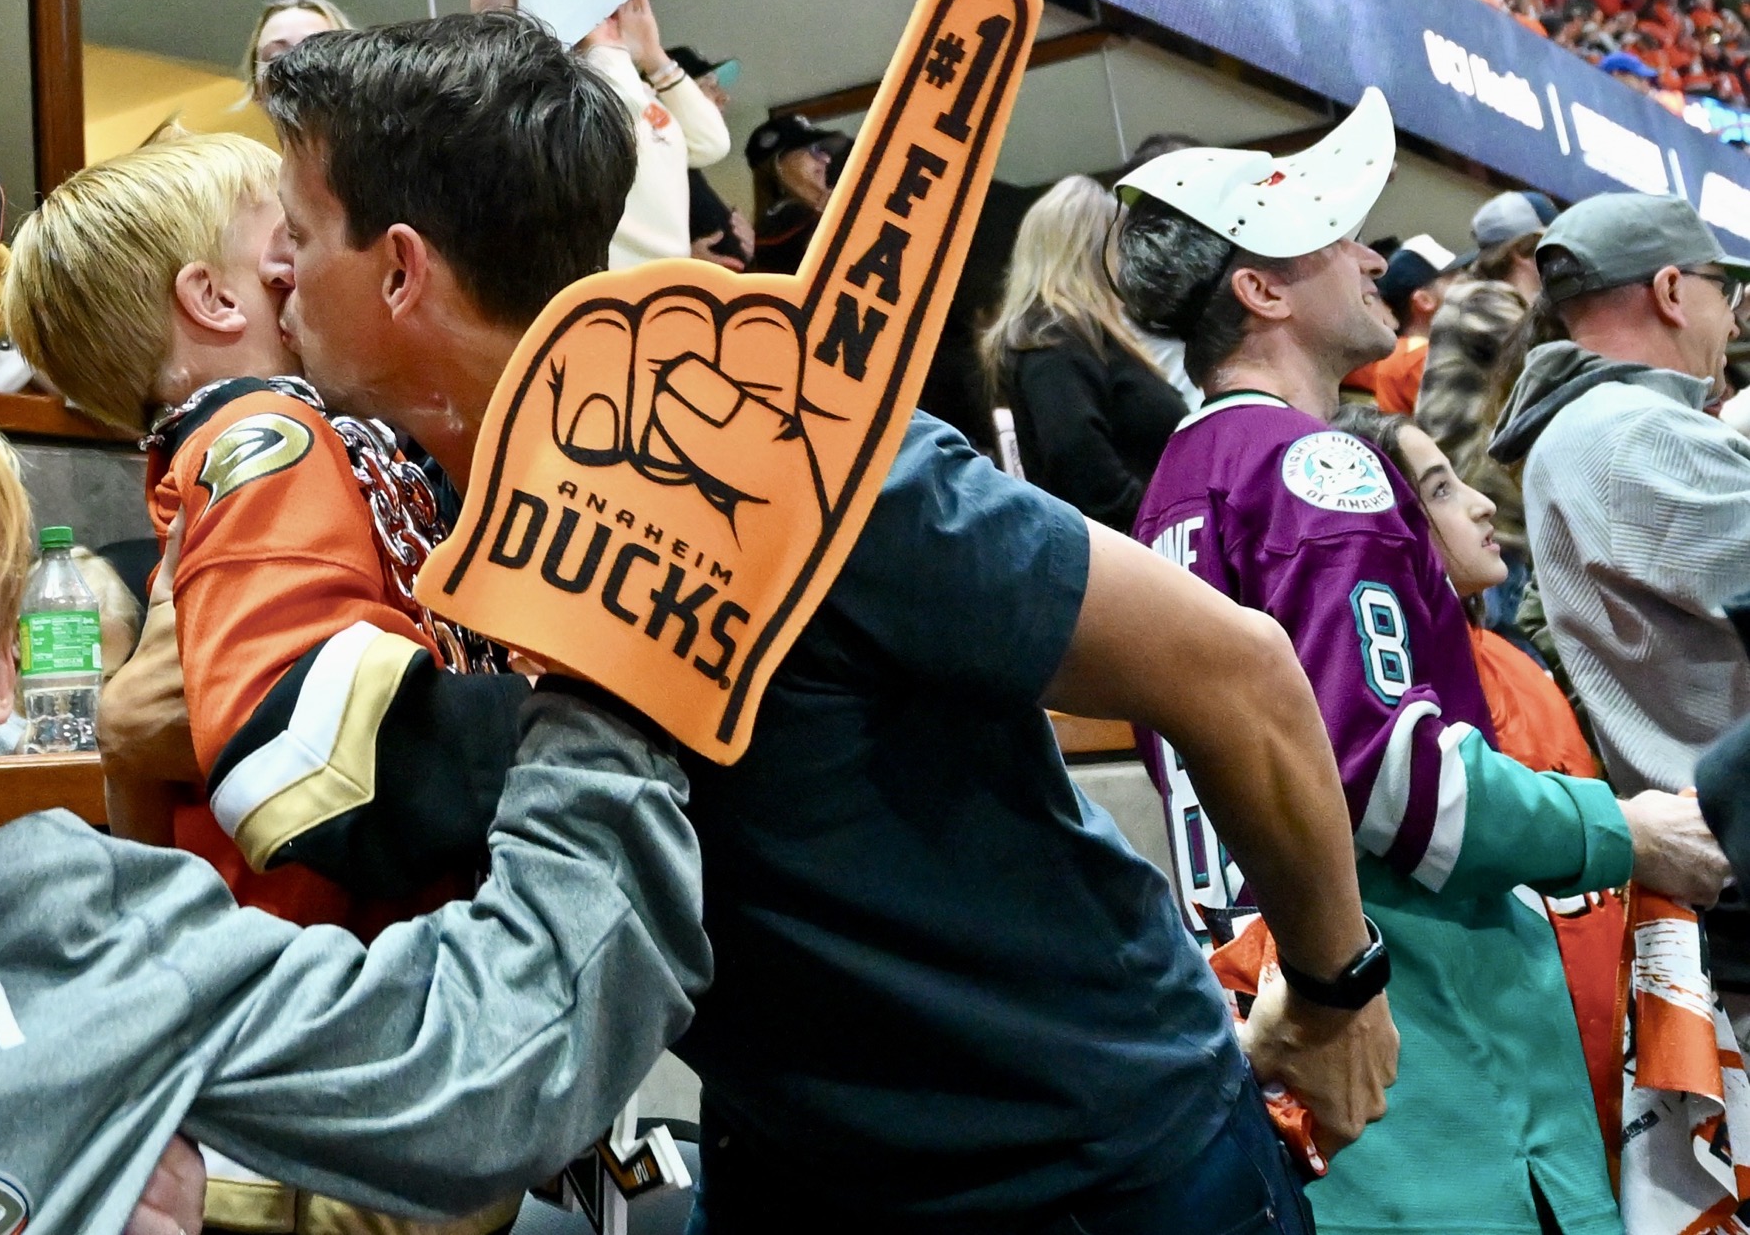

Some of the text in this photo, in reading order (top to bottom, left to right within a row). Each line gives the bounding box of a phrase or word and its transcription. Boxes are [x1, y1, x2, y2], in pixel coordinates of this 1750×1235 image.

[813, 14, 1012, 383] #1 FAN
[488, 488, 751, 681] DUCKS
[557, 480, 733, 586] ANAHEIM
[1349, 579, 1414, 707] 8
